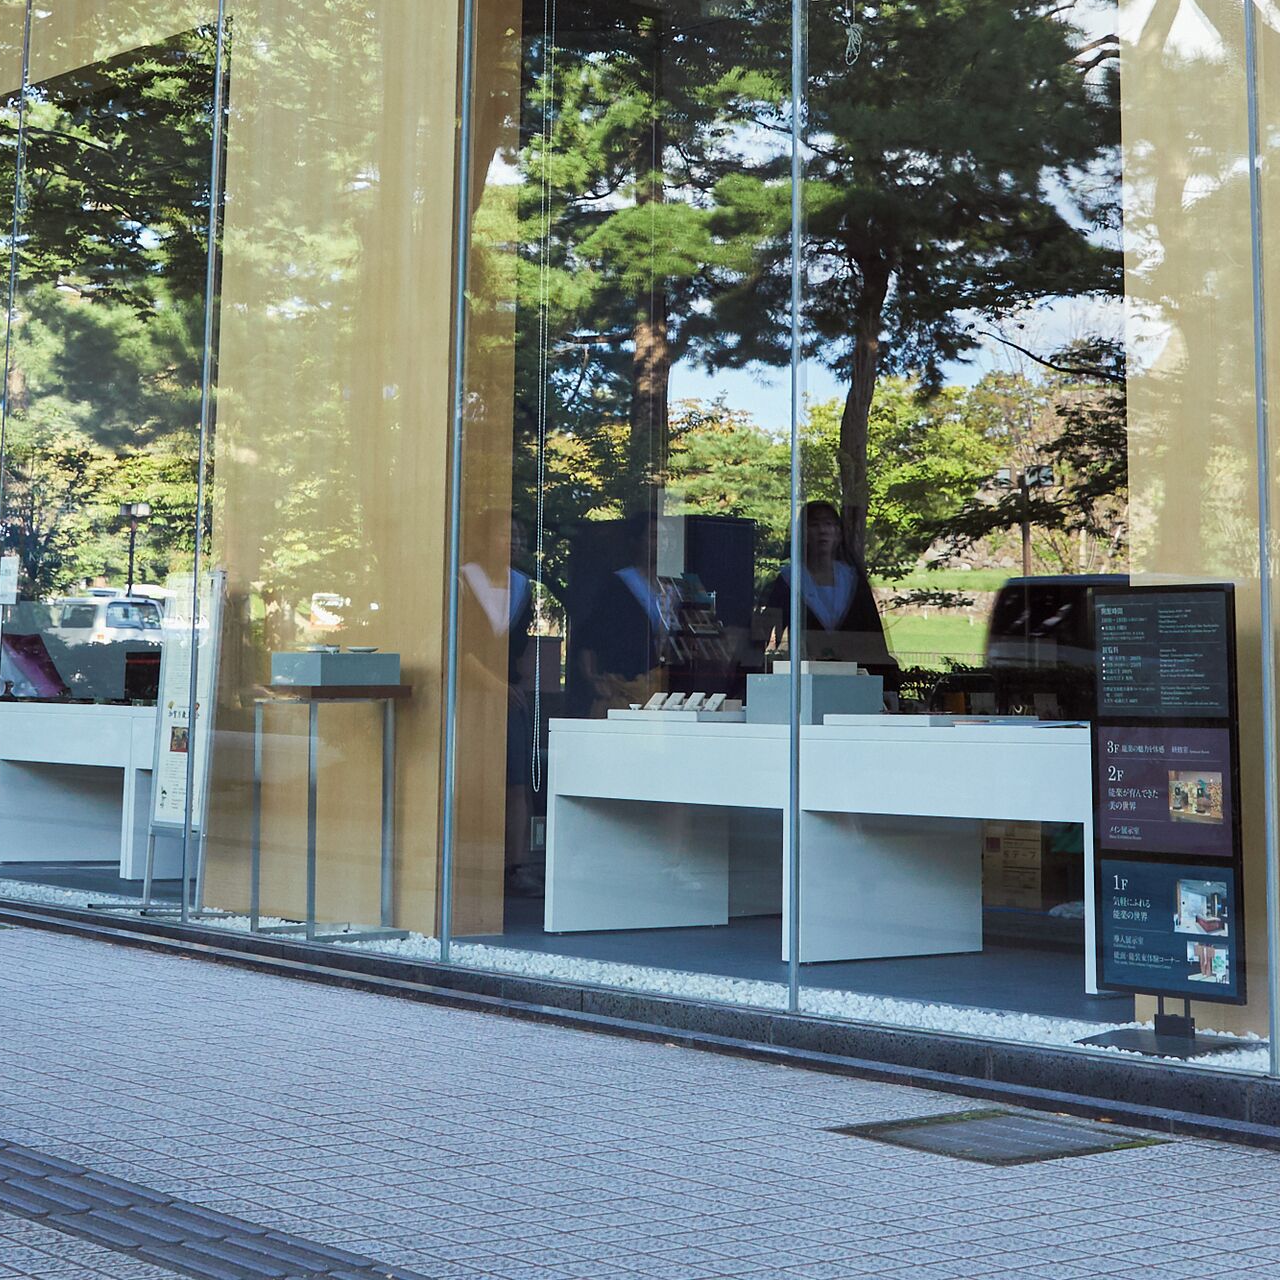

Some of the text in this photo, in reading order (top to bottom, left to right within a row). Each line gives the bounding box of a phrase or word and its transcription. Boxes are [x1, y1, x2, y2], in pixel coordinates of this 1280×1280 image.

[1107, 740, 1120, 754] 3F
[1108, 765, 1124, 782] 2F
[1113, 874, 1129, 891] 1F
